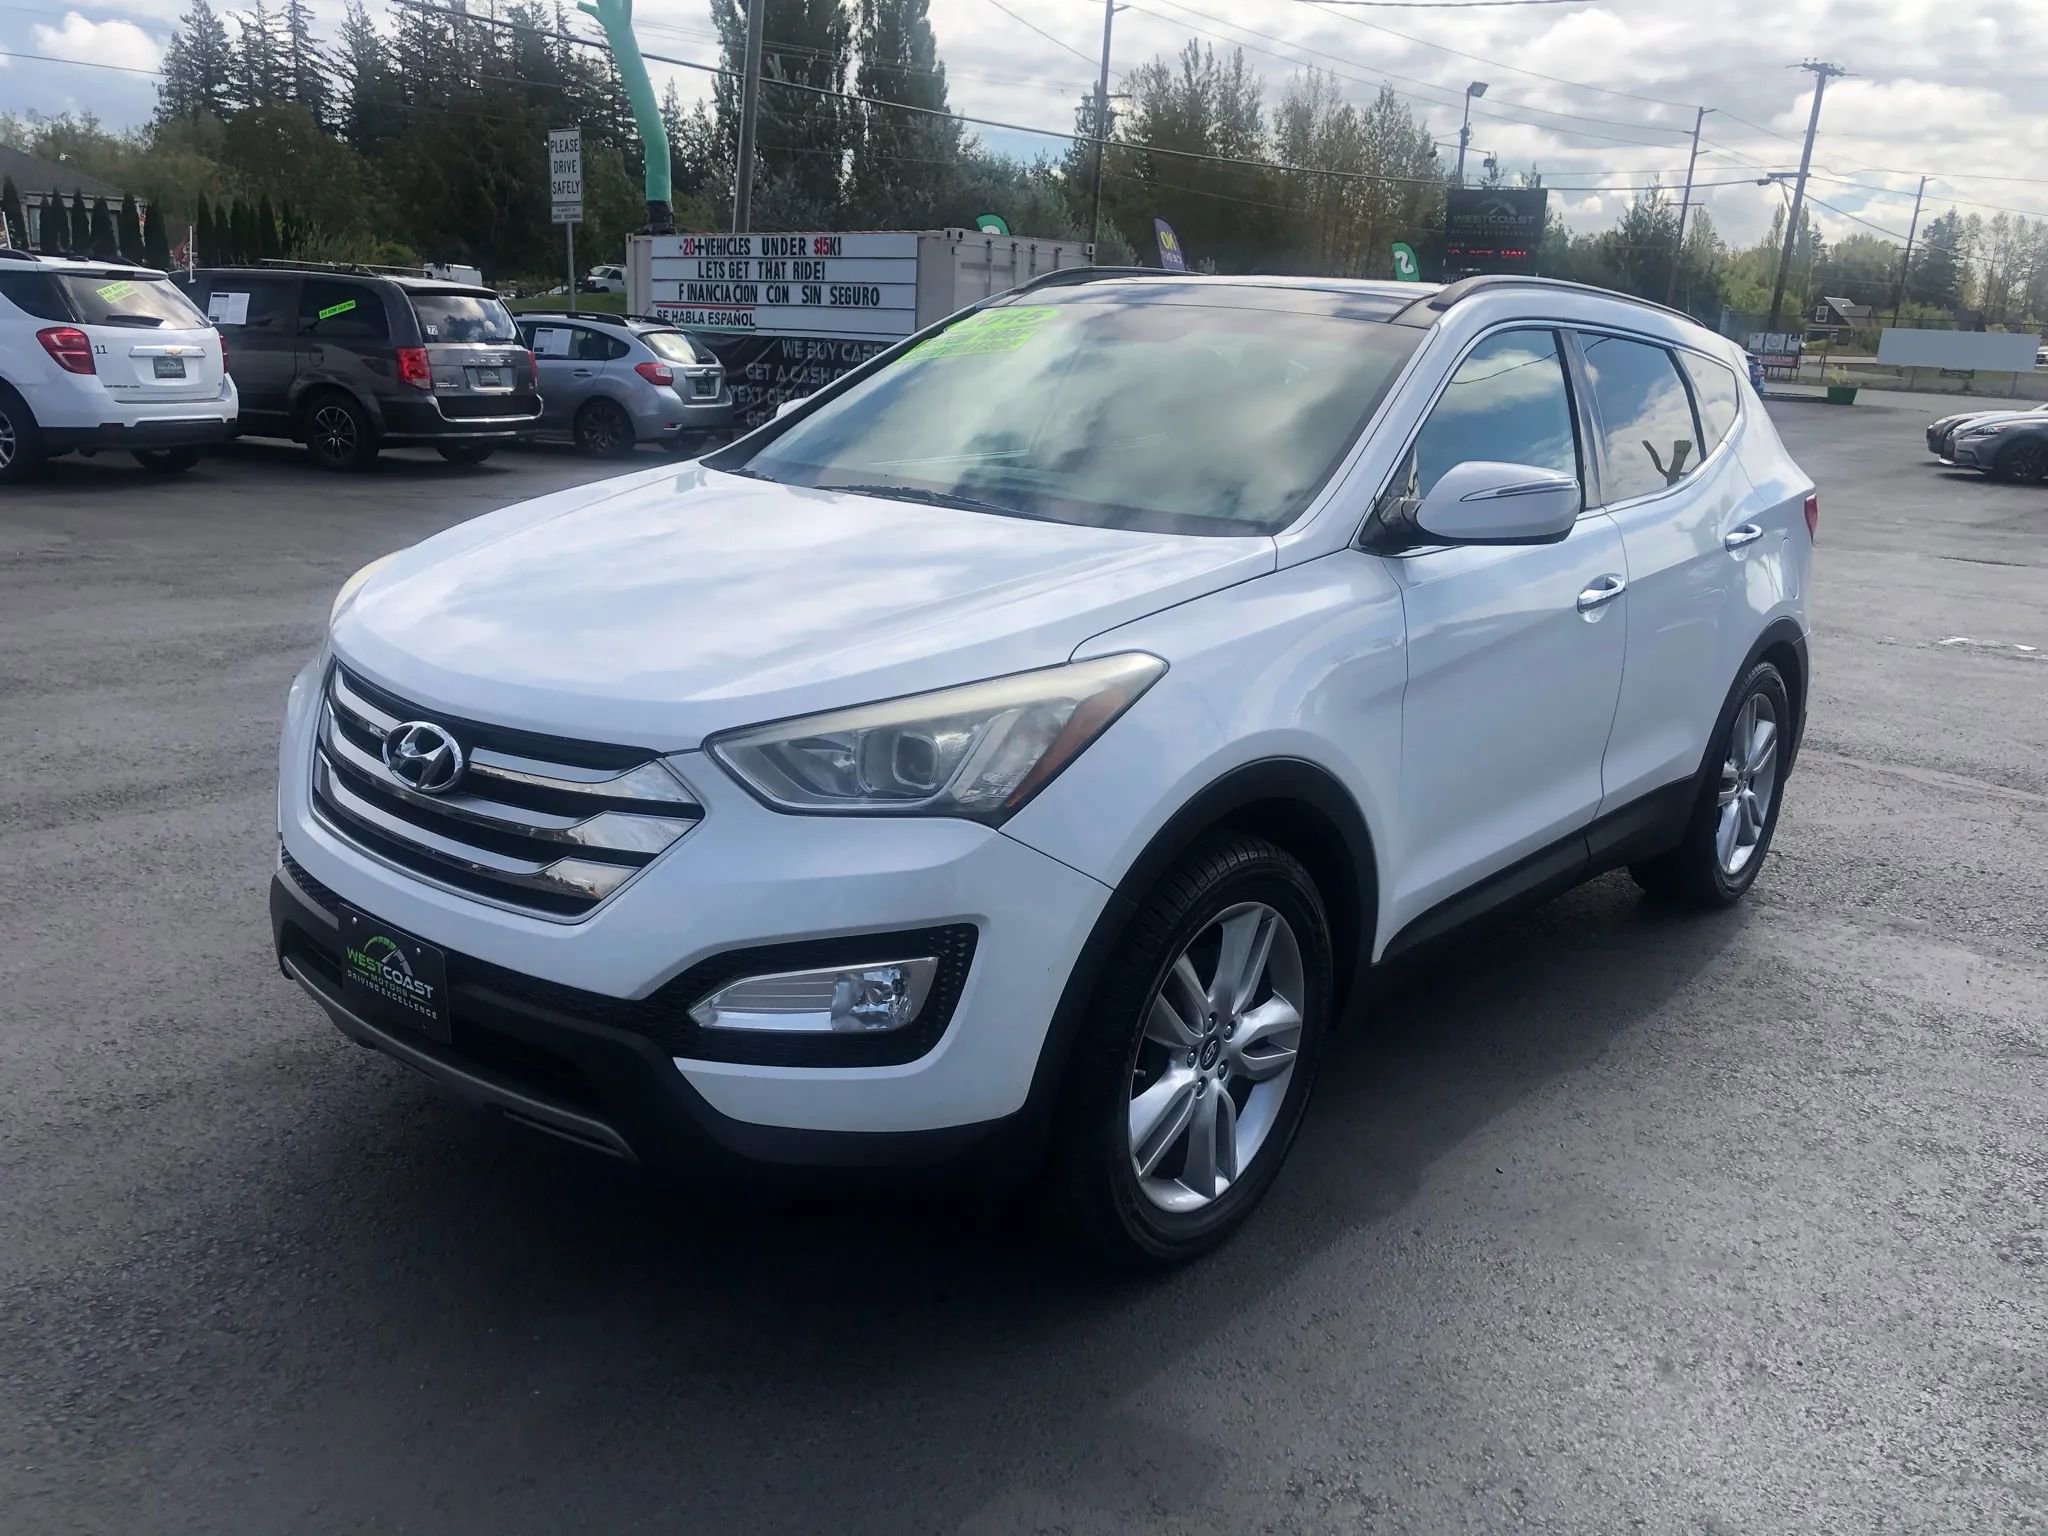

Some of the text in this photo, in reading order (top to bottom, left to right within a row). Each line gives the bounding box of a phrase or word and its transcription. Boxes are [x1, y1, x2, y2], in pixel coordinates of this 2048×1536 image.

[550, 139, 579, 153] PLEASE
[553, 160, 577, 173] DRIVE
[552, 181, 580, 195] SAFELY
[761, 237, 807, 256] UNDER
[697, 261, 826, 280] LETS GET THAT RIDE!
[766, 285, 789, 304] CON
[801, 285, 822, 305] SIN
[830, 286, 880, 306] SEGURO
[656, 309, 756, 326] SE HABLA ESPAÑOL
[94, 345, 108, 355] 11
[782, 340, 803, 359] WE
[808, 341, 837, 361] BUY
[746, 363, 772, 381] GET
[776, 365, 787, 382] A
[790, 366, 830, 384] CASH
[346, 945, 434, 999] WESTCOAST
[347, 969, 438, 1020] DRIVING EXCELLENCE
[370, 974, 408, 997] MOTORS
